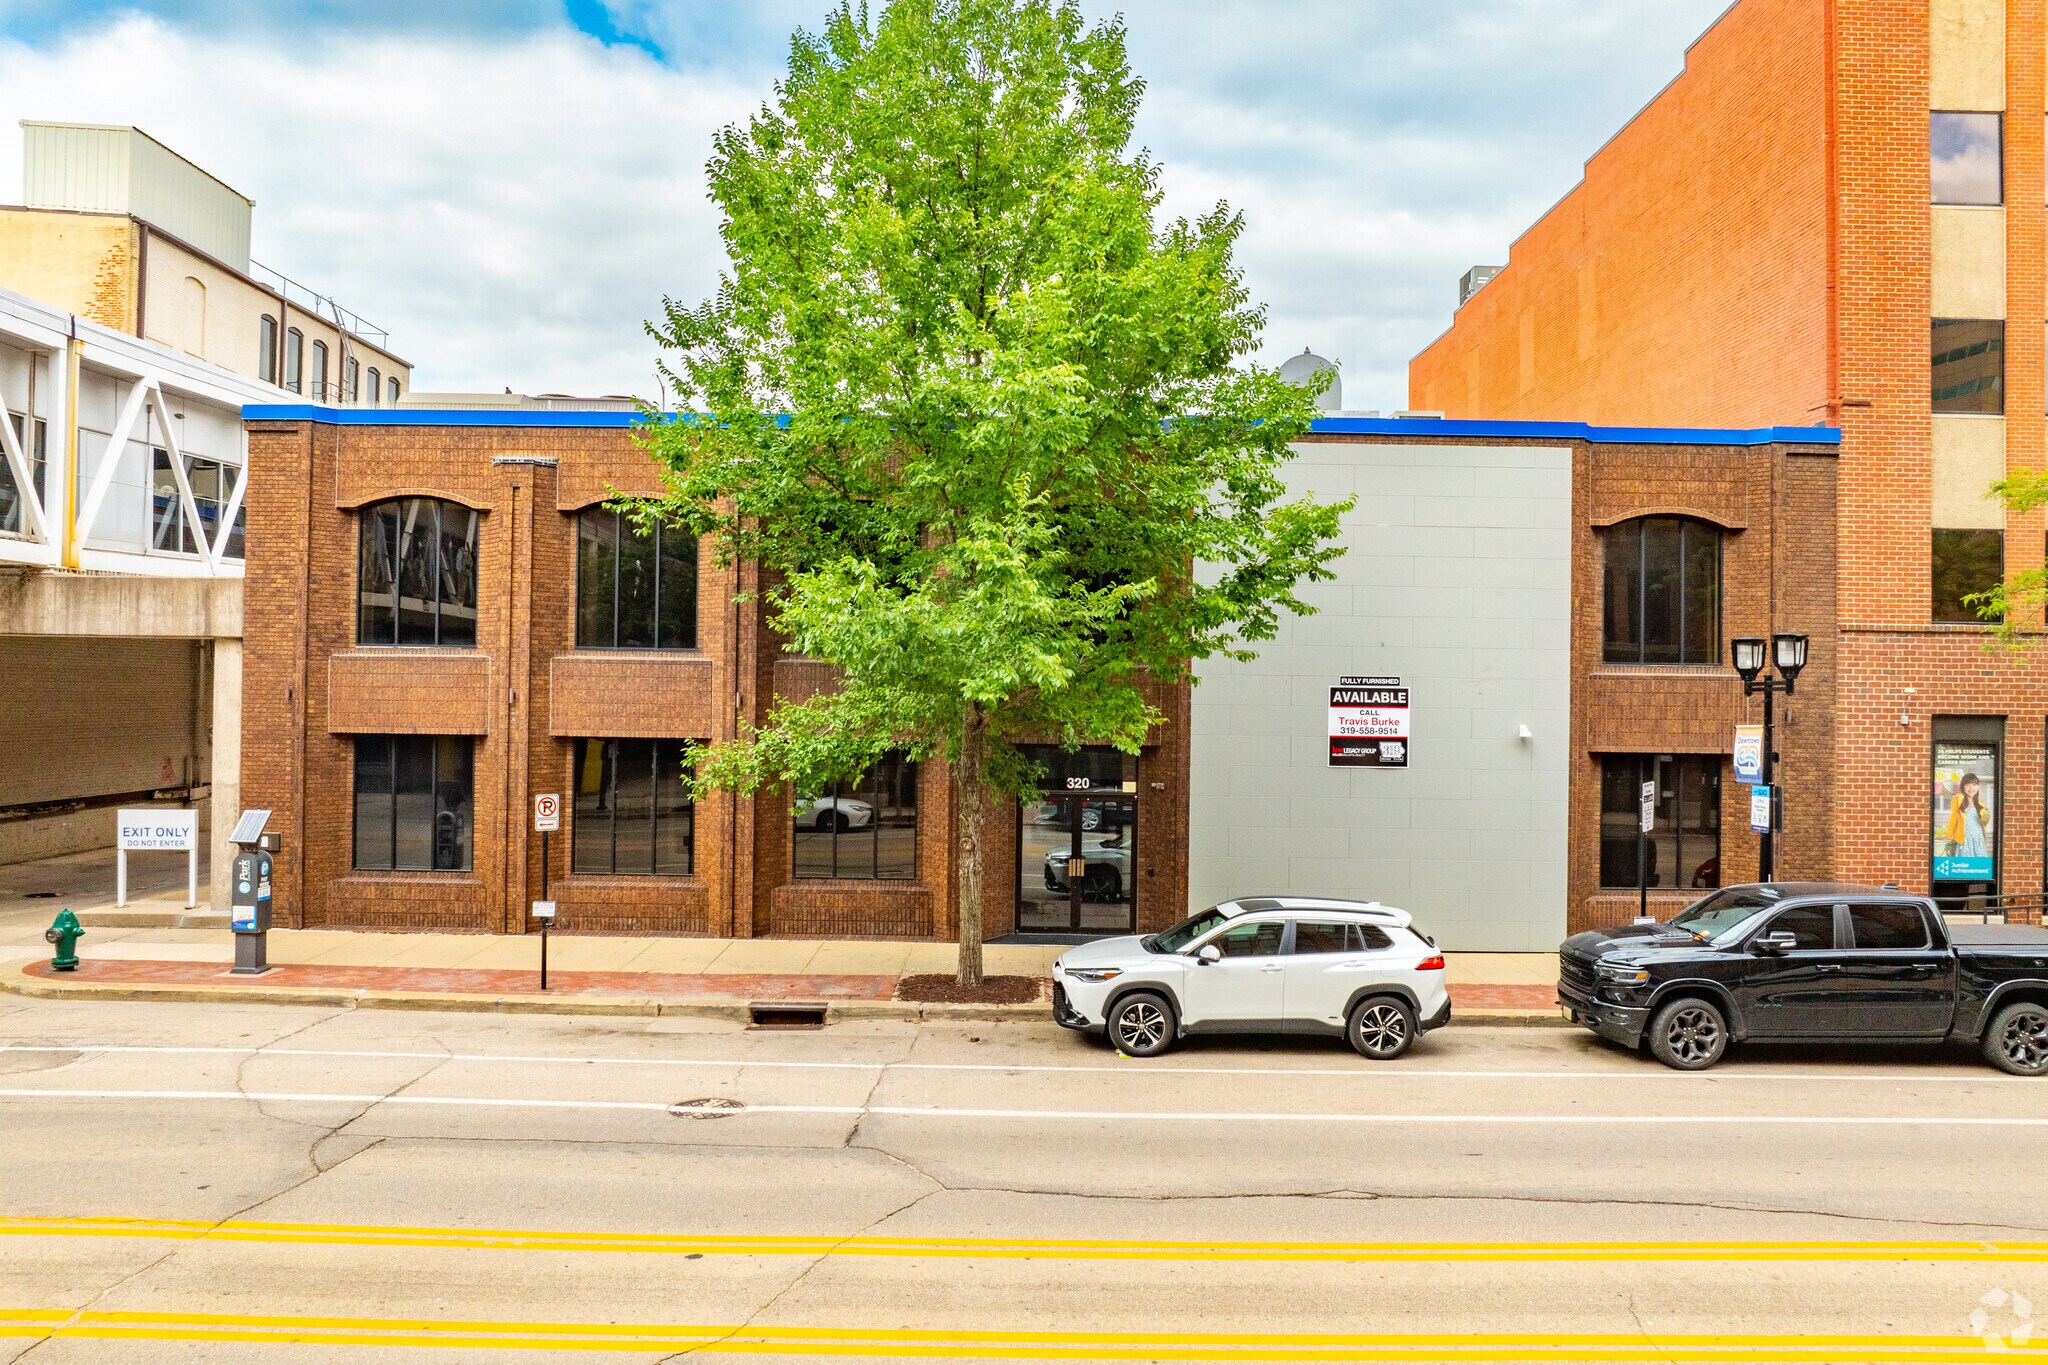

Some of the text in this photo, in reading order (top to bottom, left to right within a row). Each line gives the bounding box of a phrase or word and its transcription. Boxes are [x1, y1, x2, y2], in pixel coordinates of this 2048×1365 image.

[1333, 691, 1406, 704] AVAILABLE
[1338, 716, 1400, 726] Travis Burke
[1340, 726, 1398, 735] 319-558-9514
[1738, 736, 1760, 744] Downtown
[1383, 745, 1400, 756] 319
[1066, 777, 1090, 789] 320
[123, 827, 190, 837] EXIT ONLY
[238, 859, 249, 881] Park
